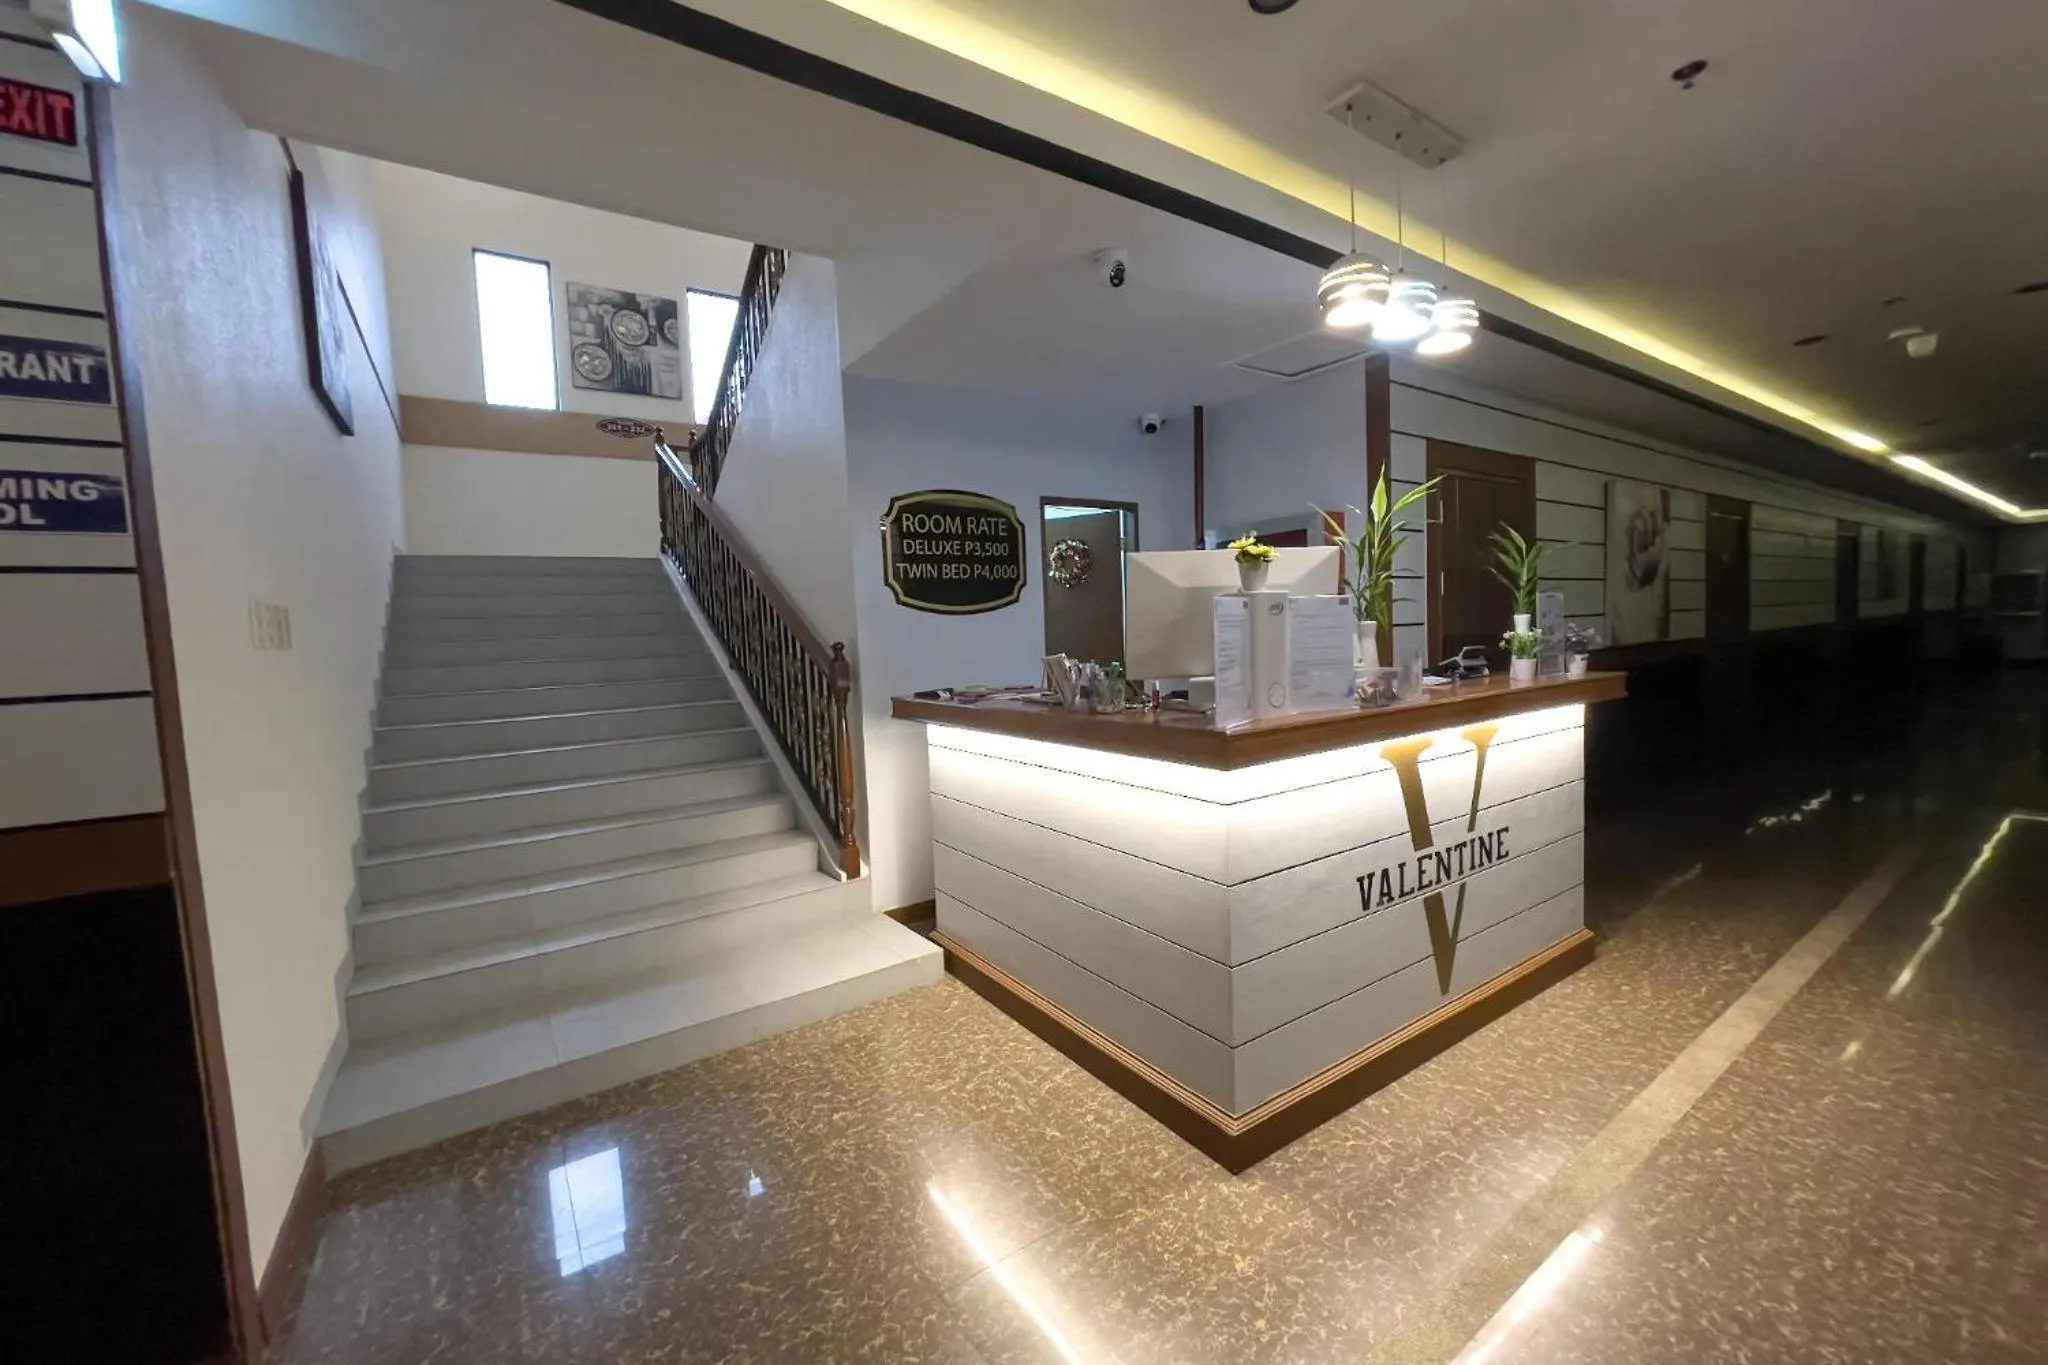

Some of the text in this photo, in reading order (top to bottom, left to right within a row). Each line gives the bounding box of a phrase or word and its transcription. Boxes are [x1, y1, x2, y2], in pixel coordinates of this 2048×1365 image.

[0, 83, 72, 138] XIT
[0, 350, 95, 384] RANT
[902, 513, 1008, 536] ROOM RATE
[903, 539, 961, 555] DELUXE
[896, 563, 938, 579] TWIN
[942, 563, 970, 579] BED
[1356, 826, 1510, 912] VALENTINE
